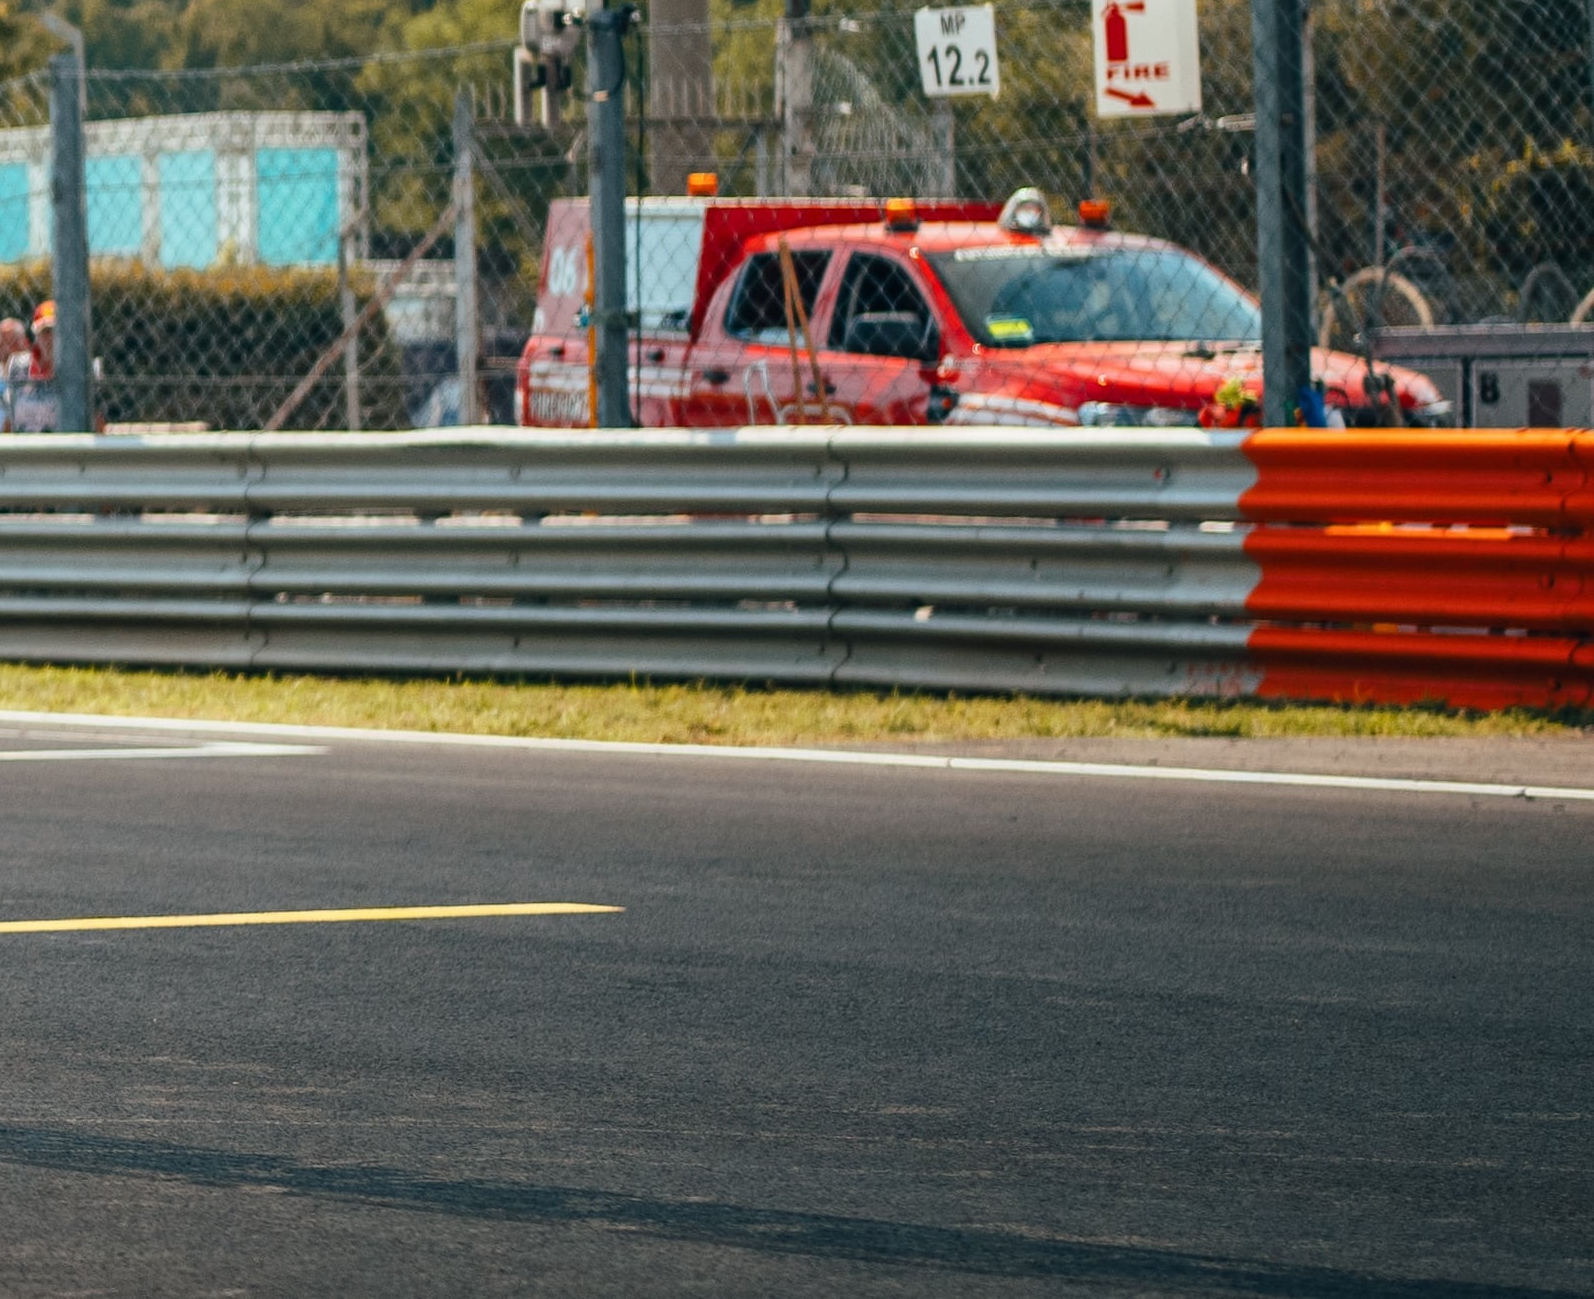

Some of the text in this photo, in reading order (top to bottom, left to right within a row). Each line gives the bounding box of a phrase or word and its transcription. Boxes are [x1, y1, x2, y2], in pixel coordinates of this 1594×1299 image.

[939, 12, 965, 34] MP
[927, 44, 991, 87] 12.2
[1106, 63, 1169, 81] FIRE
